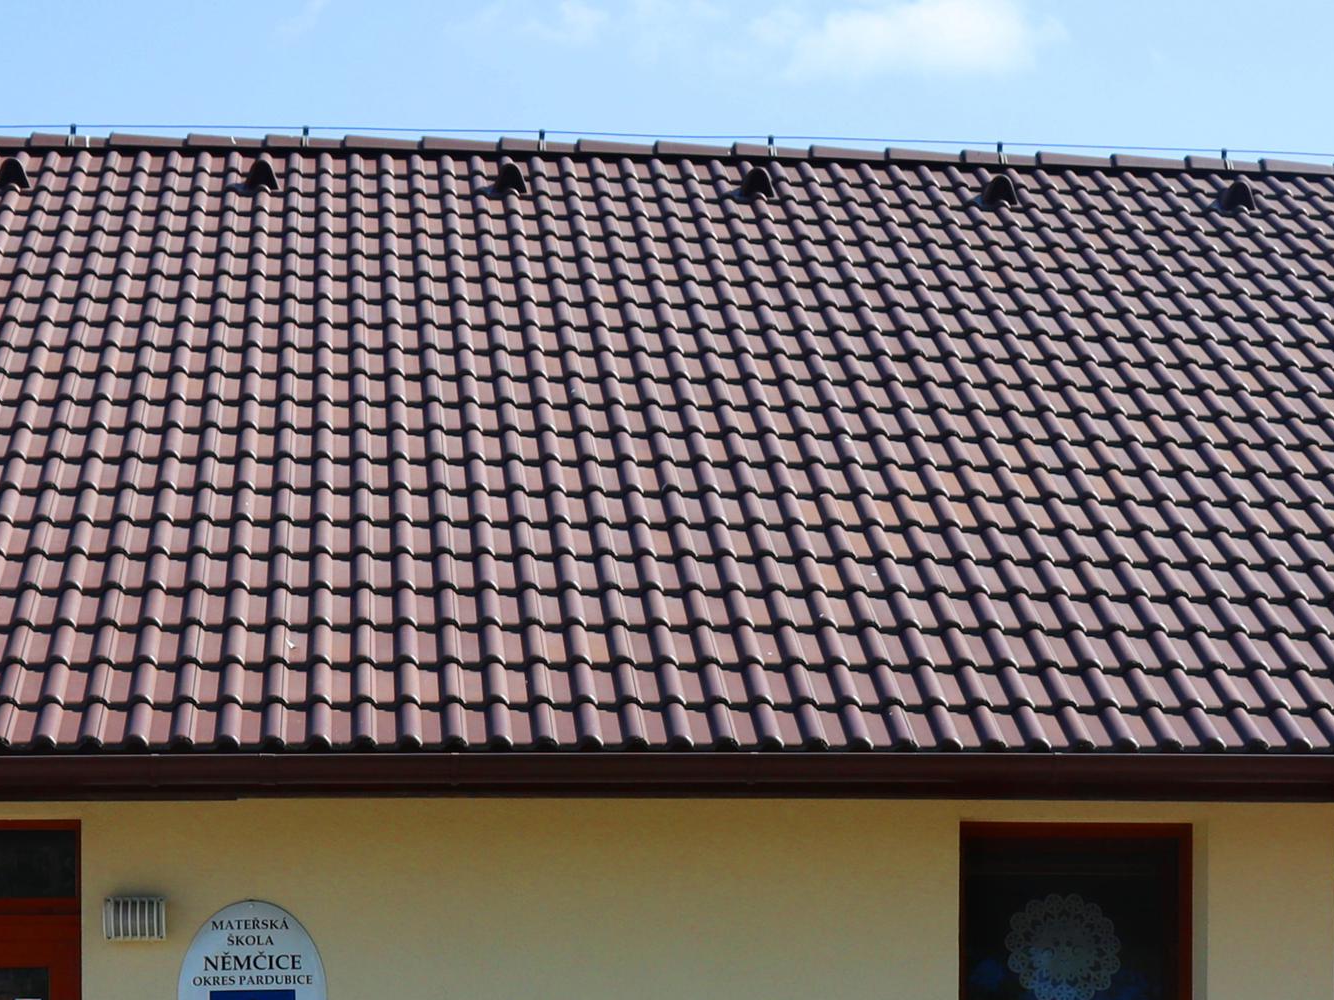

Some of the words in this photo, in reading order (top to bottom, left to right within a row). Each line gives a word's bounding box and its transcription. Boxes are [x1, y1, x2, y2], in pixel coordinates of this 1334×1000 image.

[211, 917, 289, 931] MATEŘSKÁ
[226, 934, 274, 946] ŠKOLA
[203, 951, 302, 972] NĚMČICE
[192, 975, 236, 986] OKRES
[239, 974, 313, 985] PARDUBICE
